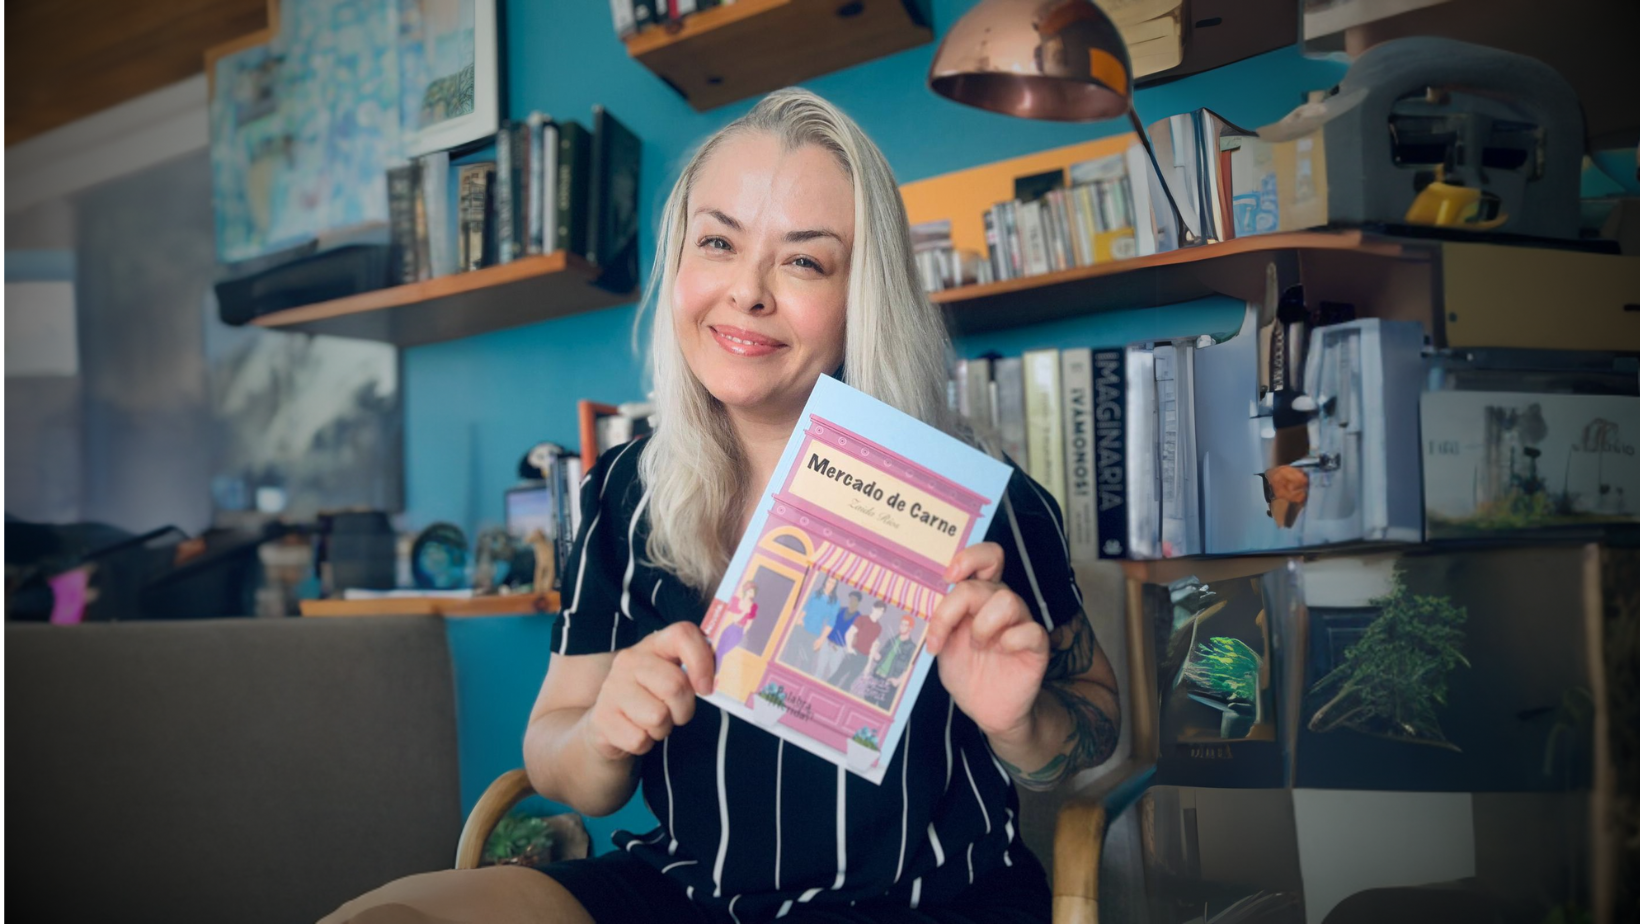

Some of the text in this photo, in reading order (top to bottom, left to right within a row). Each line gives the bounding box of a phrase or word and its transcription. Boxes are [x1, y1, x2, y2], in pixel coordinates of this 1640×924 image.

[1095, 352, 1124, 512] IMAGINARIA
[807, 453, 957, 538] Mercado de Carne
